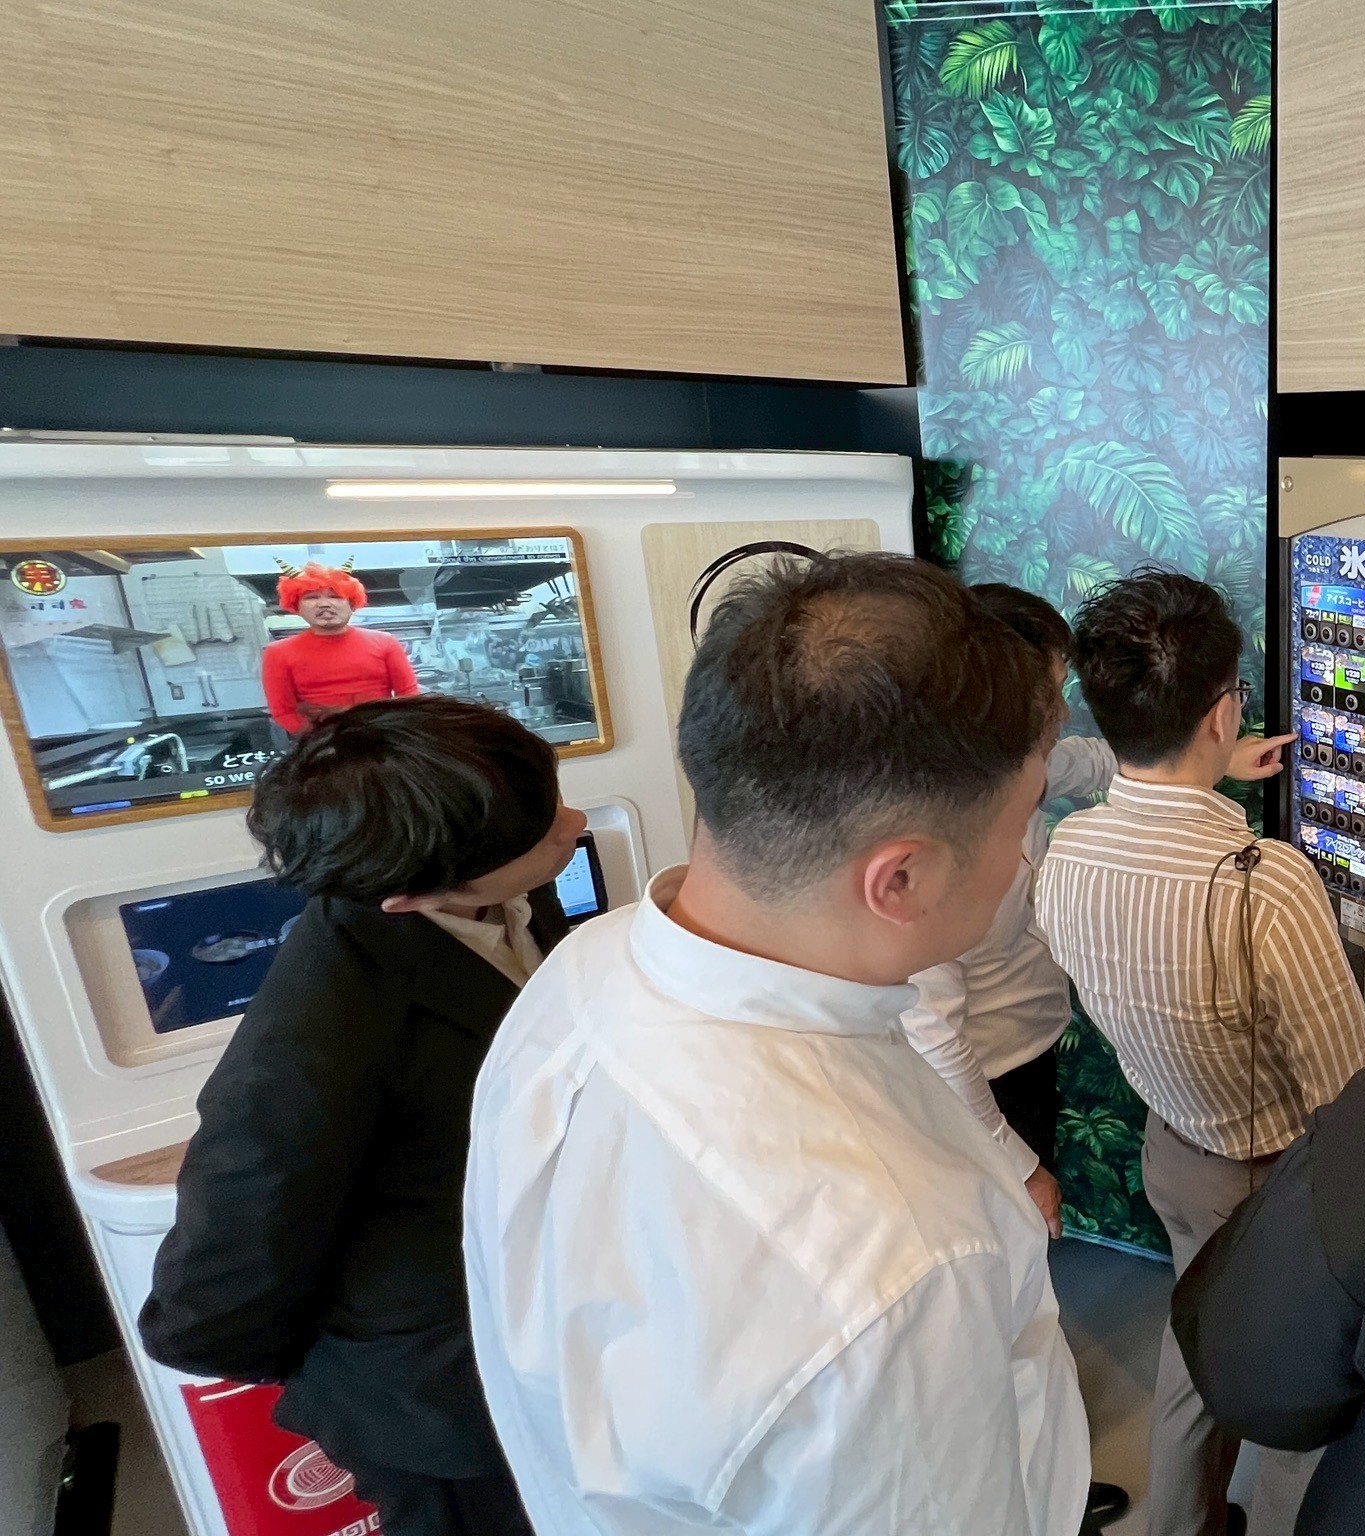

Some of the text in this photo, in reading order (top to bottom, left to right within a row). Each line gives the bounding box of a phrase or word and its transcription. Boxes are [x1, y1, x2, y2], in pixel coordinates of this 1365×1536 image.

[1306, 555, 1331, 567] COLD
[204, 773, 255, 787] so we
